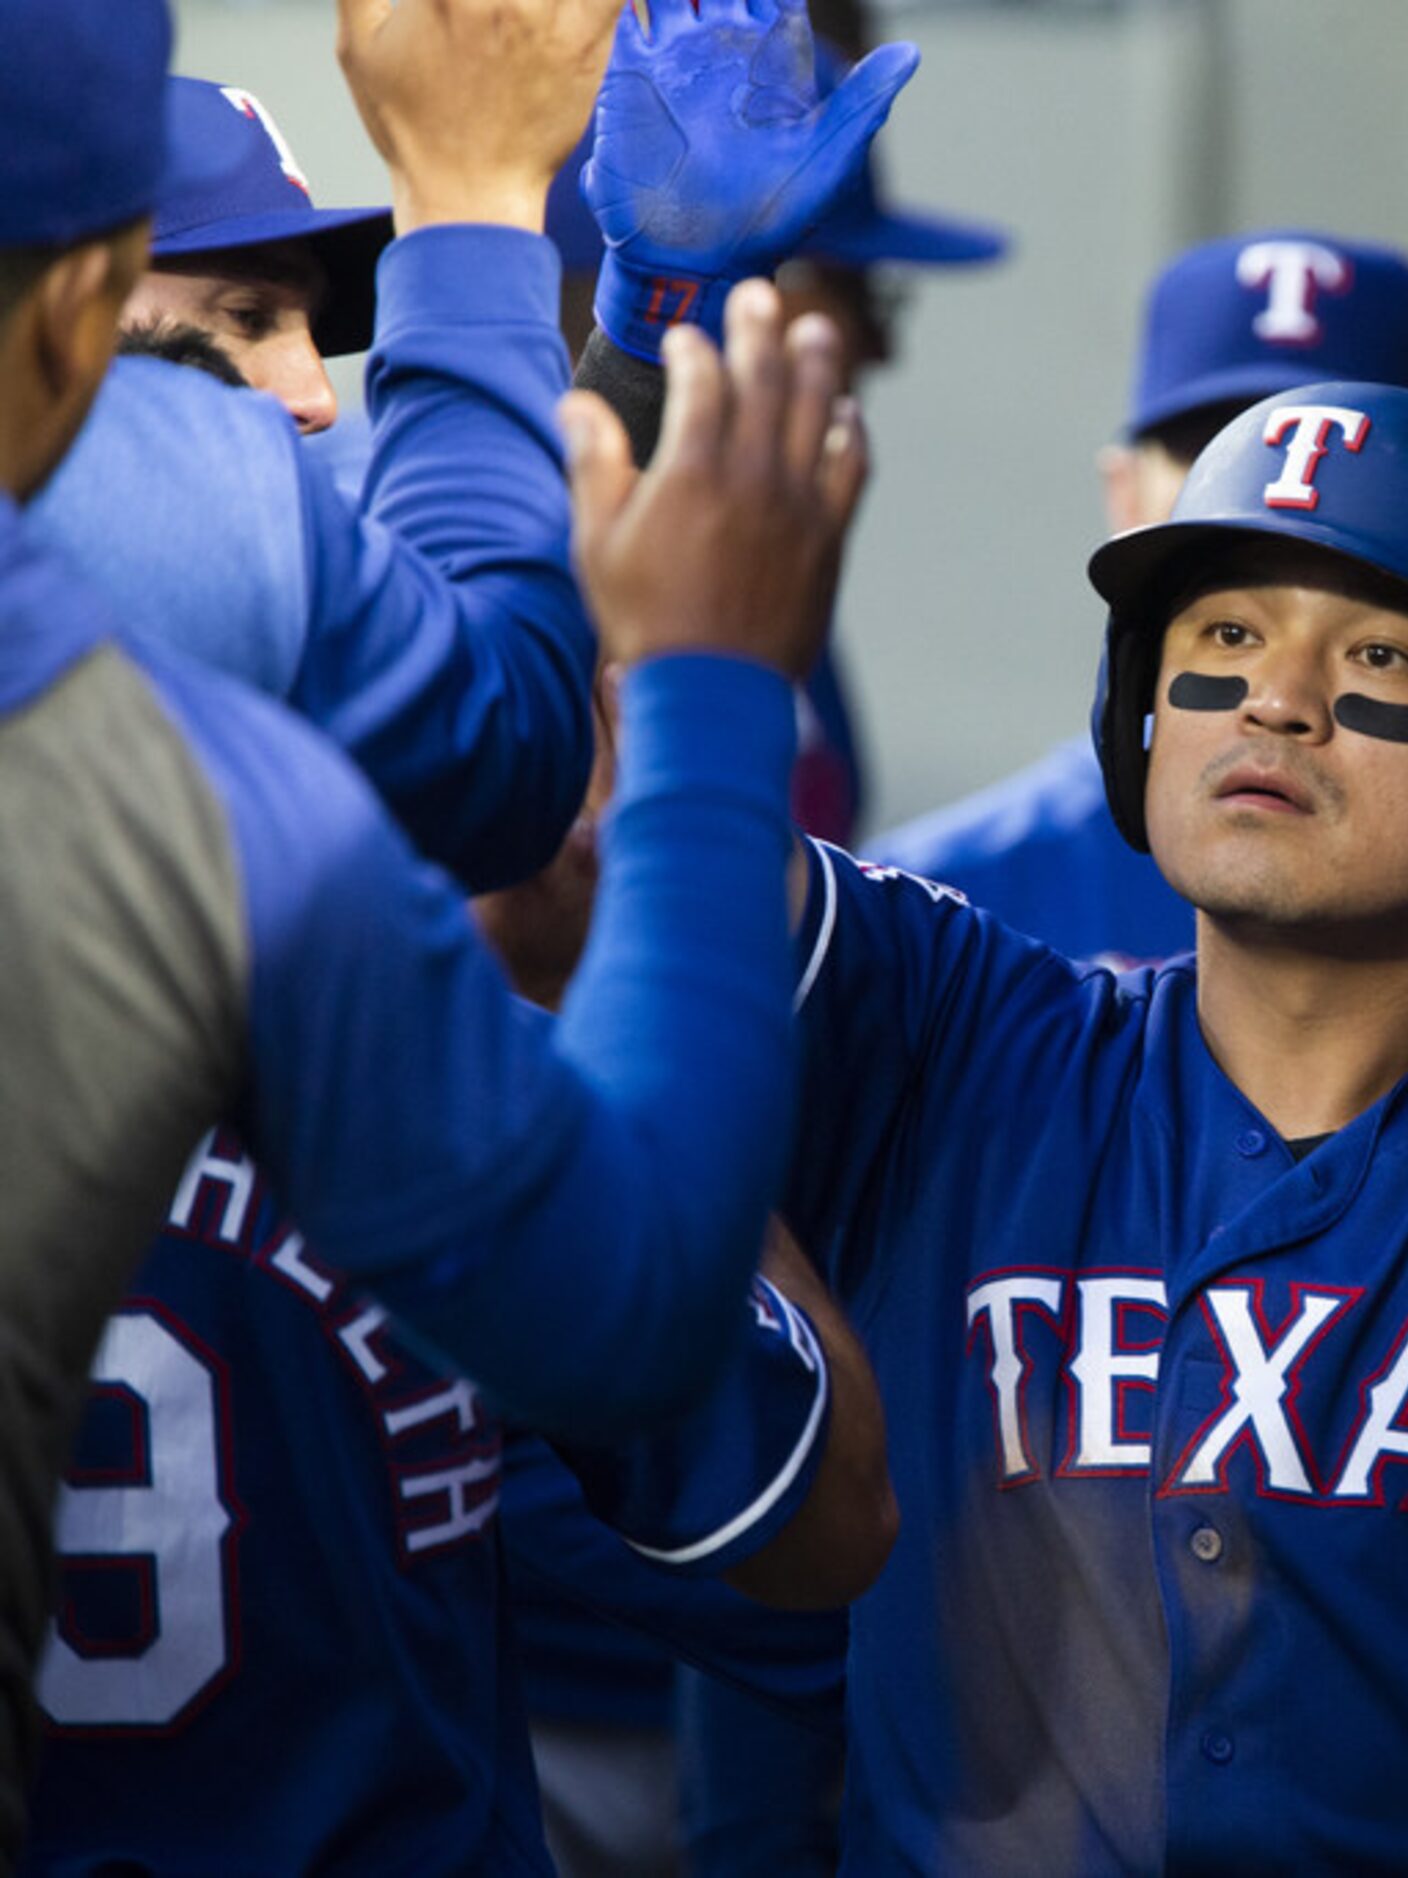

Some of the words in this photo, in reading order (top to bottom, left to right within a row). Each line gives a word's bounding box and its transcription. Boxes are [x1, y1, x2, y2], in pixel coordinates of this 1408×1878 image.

[643, 277, 699, 329] 17
[1235, 239, 1353, 346] T
[1262, 404, 1371, 511] T
